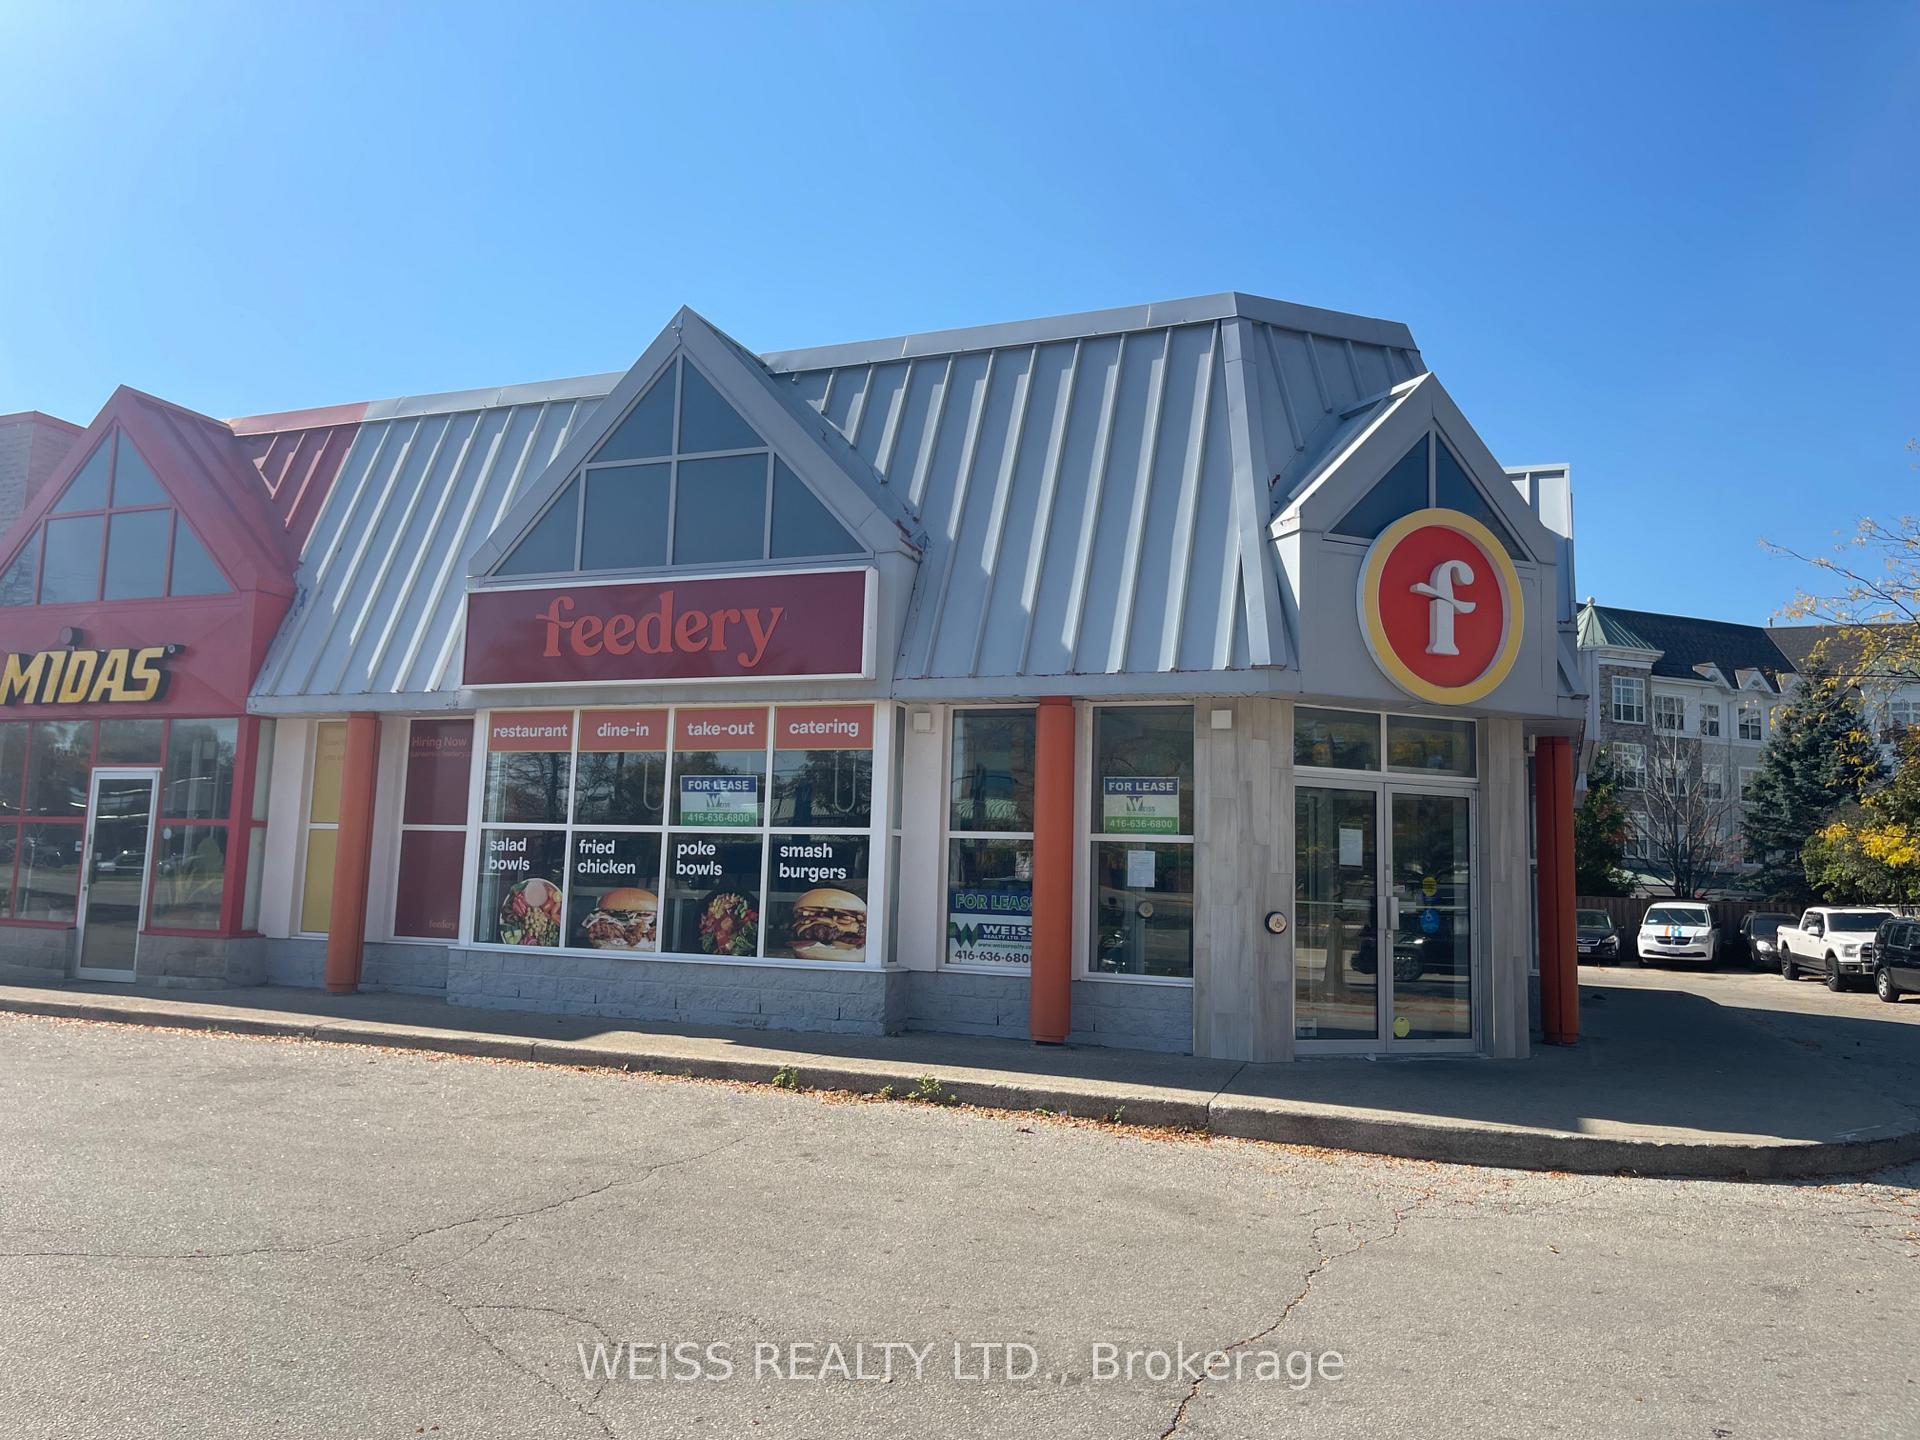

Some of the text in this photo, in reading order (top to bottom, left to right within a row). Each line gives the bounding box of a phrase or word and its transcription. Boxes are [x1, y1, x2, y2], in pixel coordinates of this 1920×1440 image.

[1409, 559, 1477, 656] f
[535, 590, 785, 668] feedery
[0, 646, 166, 705] MIDAS
[493, 724, 568, 738] restaurant
[597, 722, 649, 737] dine-in
[687, 721, 755, 736] take-out
[789, 719, 859, 738] catering
[412, 735, 467, 749] Hiring Now
[688, 780, 750, 790] FOR LEASE
[1108, 782, 1174, 792] FOR LEASE
[687, 813, 750, 822] 416-636-6800
[1109, 820, 1173, 828] 416-636-6800
[489, 837, 528, 852] salad
[579, 839, 616, 855] fried
[677, 841, 716, 858] poke
[780, 843, 833, 858] smash
[489, 857, 530, 871] bowls
[577, 859, 637, 874] chicken
[676, 861, 723, 876] bowls
[779, 863, 847, 883] burgers
[955, 893, 1032, 912] FOR LEAS
